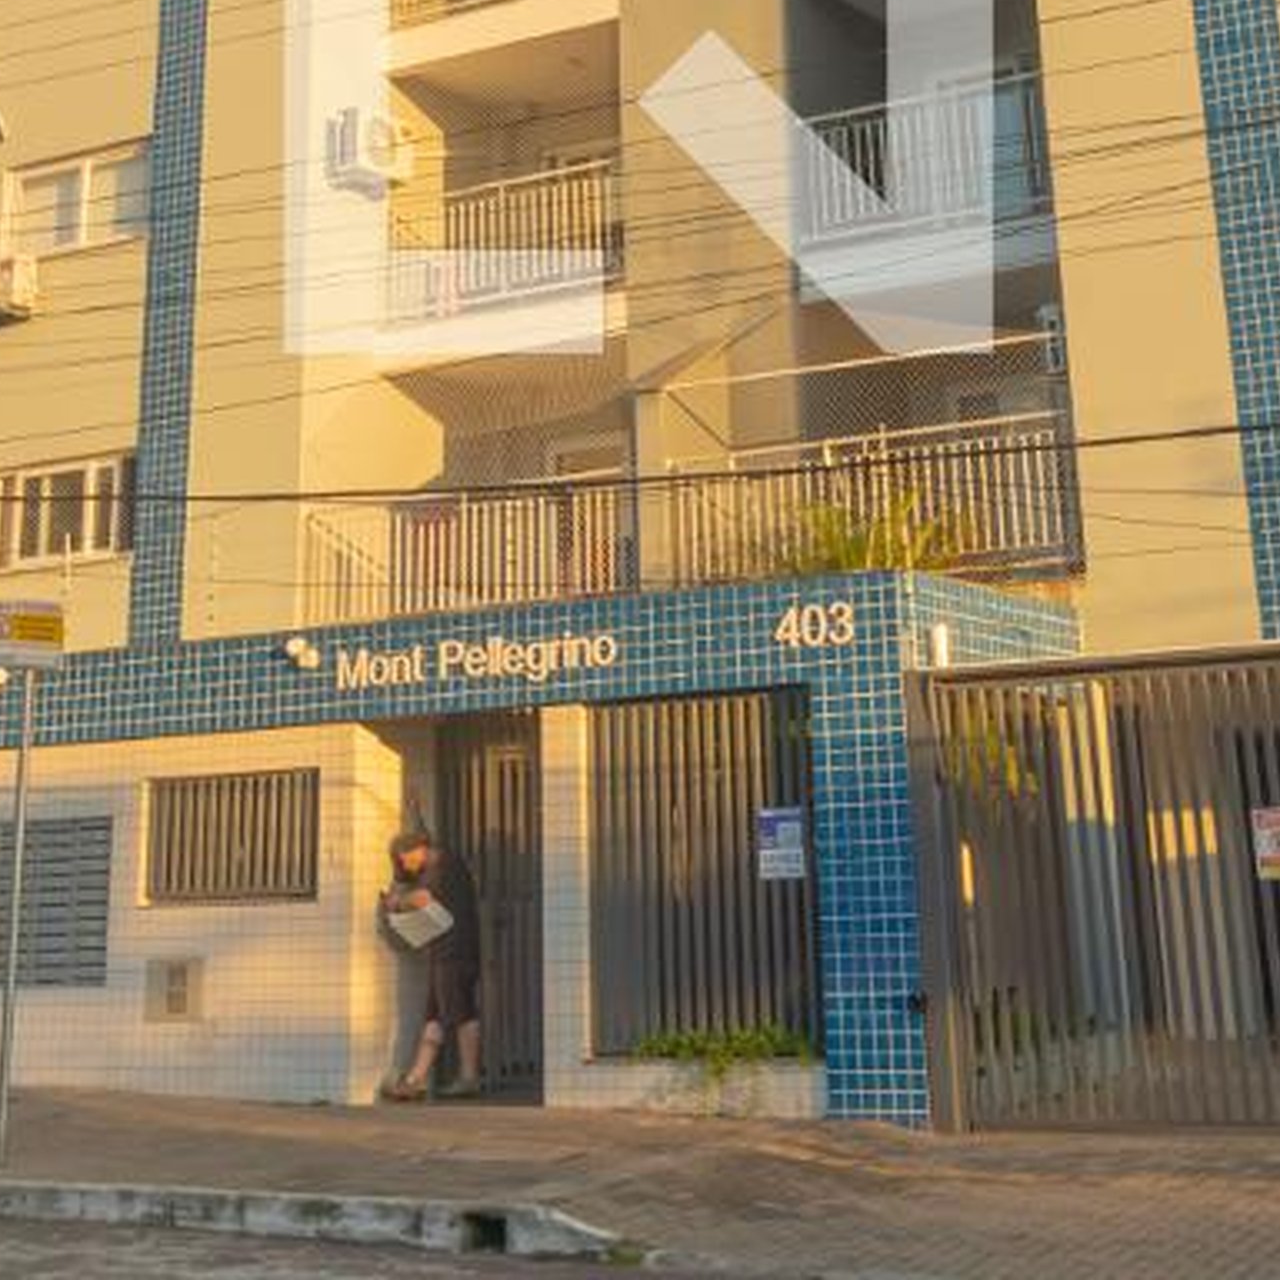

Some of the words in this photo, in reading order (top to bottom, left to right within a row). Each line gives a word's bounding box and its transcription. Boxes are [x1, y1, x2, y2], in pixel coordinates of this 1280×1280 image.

[774, 601, 855, 647] 403
[335, 643, 426, 691] Mont
[438, 631, 618, 681] Pellegrino
